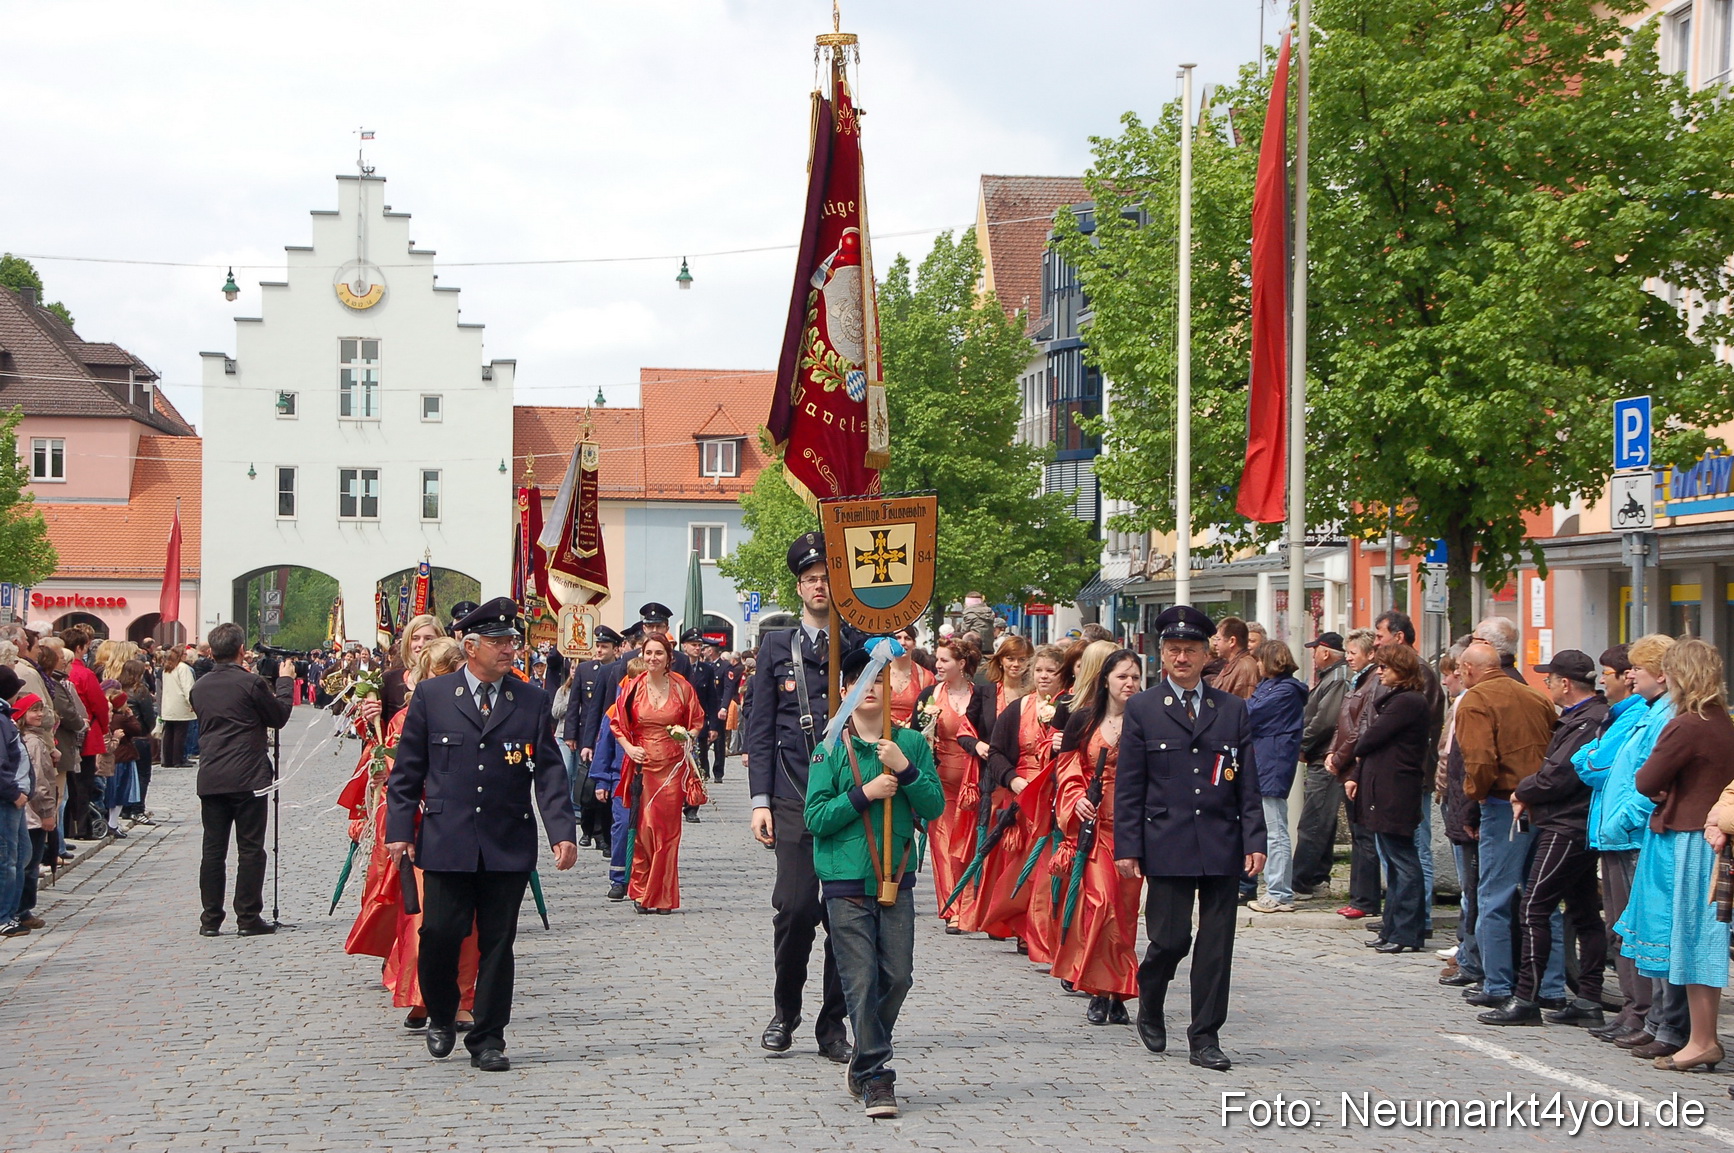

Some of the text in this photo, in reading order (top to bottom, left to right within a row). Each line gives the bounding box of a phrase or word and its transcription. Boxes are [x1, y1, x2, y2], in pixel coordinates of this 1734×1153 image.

[1622, 407, 1643, 460] P
[1625, 479, 1639, 489] nur
[833, 502, 926, 524] Freiwillige Feuerwehr
[831, 556, 842, 569] 18
[918, 550, 932, 563] 84
[31, 592, 127, 610] Sparkasse
[752, 594, 758, 611] P
[744, 603, 750, 620] P
[839, 598, 922, 630] Pavelsbach
